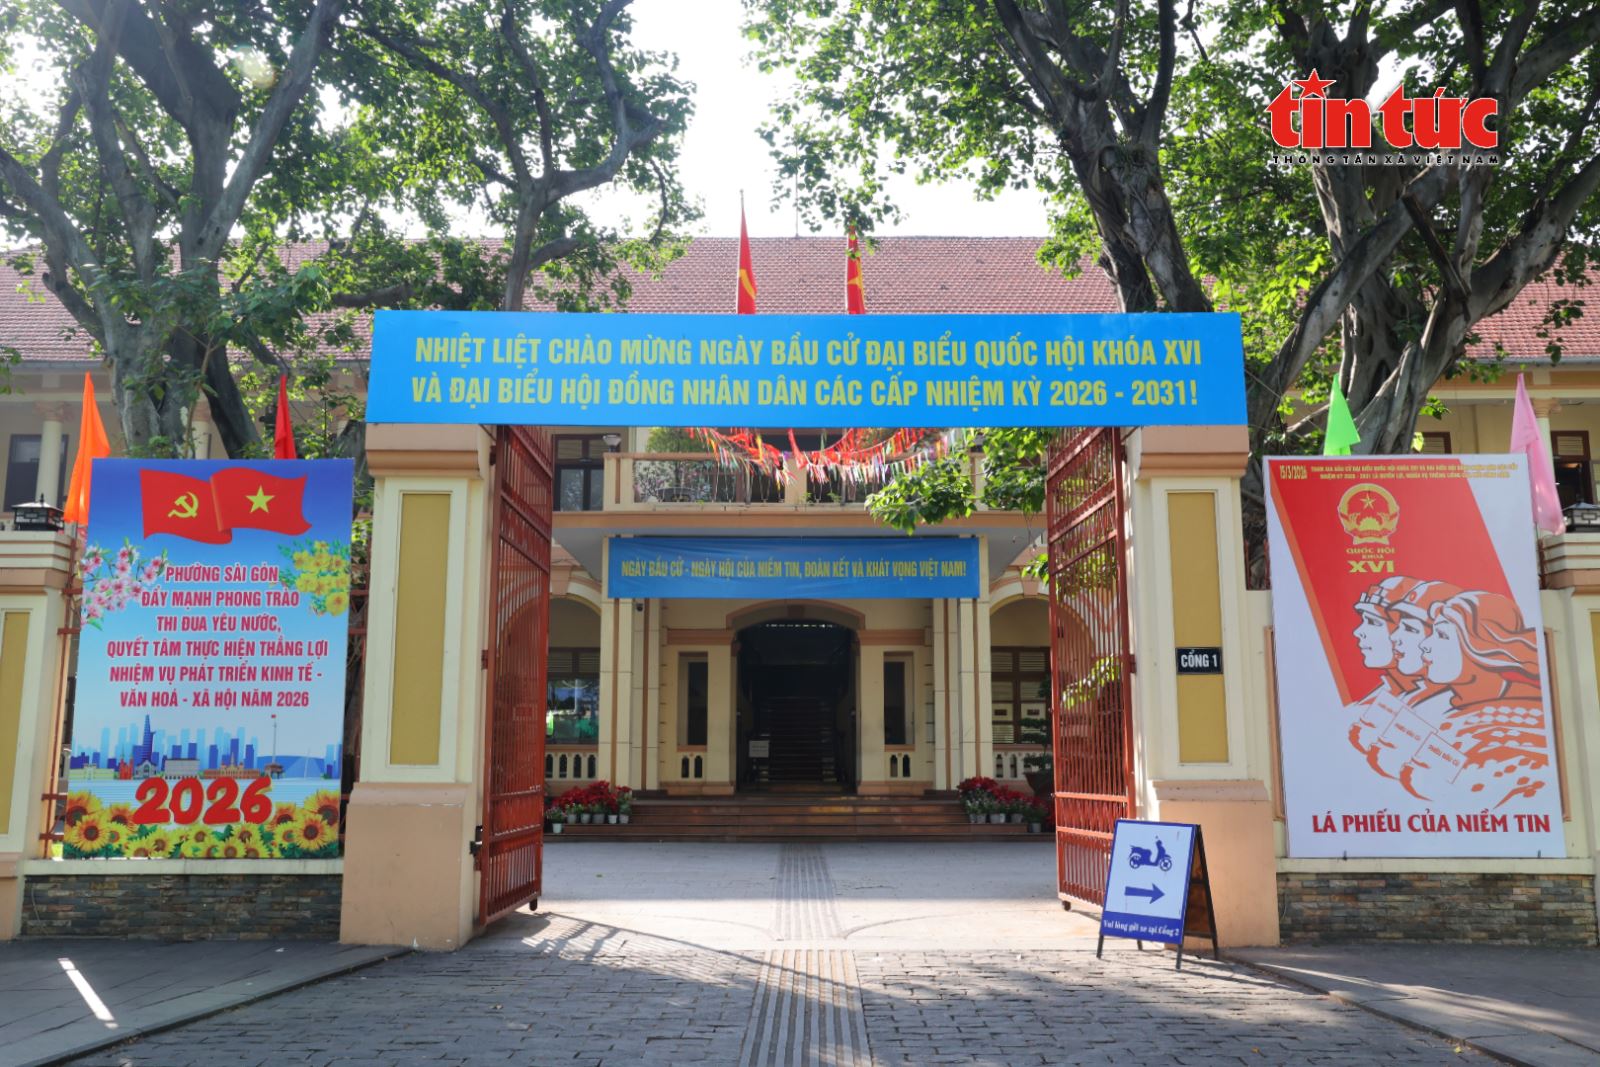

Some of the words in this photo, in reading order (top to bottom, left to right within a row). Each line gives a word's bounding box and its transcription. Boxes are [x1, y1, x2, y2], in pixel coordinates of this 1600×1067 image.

[416, 332, 486, 368] NHIỆT
[493, 332, 541, 370] LIỆT
[548, 334, 612, 365] CHÀO
[620, 333, 692, 366] MỪNG
[700, 335, 763, 366] NGÀY
[771, 332, 818, 366] BẦU
[827, 331, 860, 366] CỬ
[866, 340, 904, 372] ĐẠI
[913, 331, 966, 366] BIỂU
[975, 331, 1037, 369] QUỐC
[1046, 335, 1084, 372] HỘI
[1093, 335, 1156, 366] KHÓA
[1164, 340, 1201, 365] XVI
[412, 371, 441, 403] VÀ
[450, 377, 490, 409] ĐẠI
[498, 368, 553, 405] BIỂU
[561, 373, 601, 410] HỘI
[608, 370, 674, 405] ĐỒNG
[683, 374, 749, 406] NHÂN
[758, 374, 806, 406] DÂN
[815, 374, 862, 406] CÁC
[871, 370, 918, 406] CẤP
[926, 375, 1004, 411] NHIỆM
[1013, 375, 1041, 406] KỲ
[1050, 380, 1107, 405] 2026
[1132, 380, 1198, 405] 2031!
[166, 563, 220, 582] PHƯỜNG
[224, 563, 247, 581] SÀI
[251, 563, 278, 582] GÒN
[621, 557, 645, 577] NGÀY
[649, 556, 668, 577] BẦU
[670, 555, 684, 577] CỬ
[691, 558, 715, 577] NGÀY
[718, 558, 734, 581] HỘI
[737, 556, 755, 577] CỦA
[805, 558, 830, 577] ĐOÀN
[832, 556, 849, 577] KẾT
[852, 558, 864, 577] VÀ
[866, 558, 889, 577] KHÁT
[892, 561, 917, 581] VỌNG
[919, 558, 938, 581] VIỆT
[1347, 560, 1395, 573] XVI
[141, 586, 168, 607] ĐẨY
[172, 591, 212, 609] MẠNH
[215, 591, 261, 607] PHONG
[266, 587, 299, 607] TRÀO
[157, 616, 177, 631] THI
[181, 616, 207, 631] ĐUA
[212, 612, 236, 631] YÊU
[241, 613, 281, 633] NƯỚC,
[107, 636, 148, 658] QUYẾT
[153, 637, 181, 657] TÂM
[186, 641, 220, 660] THỰC
[224, 637, 255, 660] HIỆN
[307, 641, 328, 660] LỢI
[1181, 649, 1209, 668] CỔNG
[1212, 654, 1218, 667] 1
[110, 662, 154, 685] NHIỆM
[159, 666, 175, 685] VỤ
[180, 663, 214, 681] PHÁT
[218, 660, 256, 682] TRIỂN
[261, 666, 293, 681] KINH
[298, 662, 314, 681] TẾ
[120, 688, 146, 707] VĂN
[152, 687, 178, 707] HOÁ
[192, 688, 210, 707] XÃ
[214, 688, 237, 710] HỘI
[241, 688, 272, 707] NĂM
[276, 691, 309, 707] 2026
[133, 776, 273, 825] 2026
[1312, 811, 1336, 833] LÁ
[1343, 808, 1401, 833] PHIẾU
[1408, 808, 1451, 833] CỦA
[1458, 808, 1508, 833] NIỀM
[1514, 815, 1550, 833] TIN
